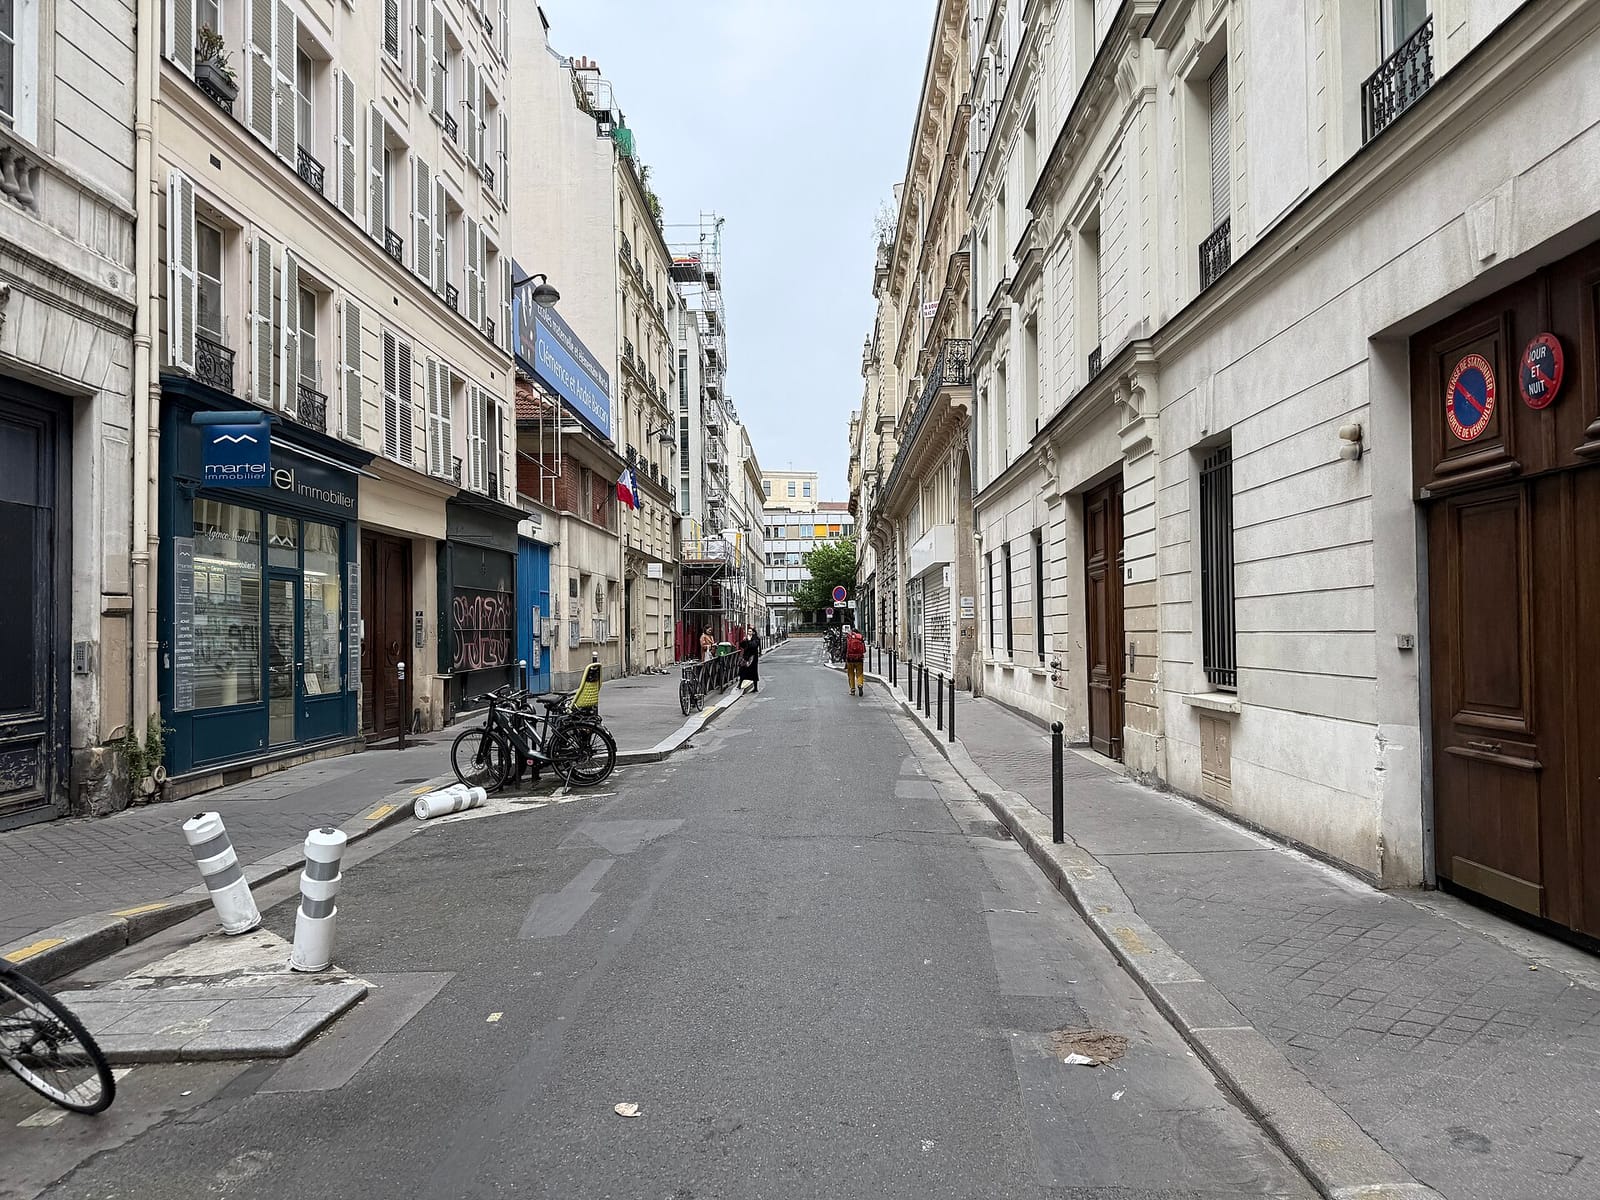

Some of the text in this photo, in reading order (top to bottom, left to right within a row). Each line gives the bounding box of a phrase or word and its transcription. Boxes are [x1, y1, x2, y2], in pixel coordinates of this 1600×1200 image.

[1527, 345, 1547, 363] JOUR
[538, 338, 569, 388] Clémence
[569, 375, 576, 395] et
[576, 378, 591, 409] André
[1467, 356, 1493, 391] STATIONNER
[1531, 363, 1541, 378] ET
[1528, 379, 1545, 395] NUIT
[1461, 427, 1469, 438] DE
[205, 462, 266, 473] martel
[297, 480, 356, 509] immobilier
